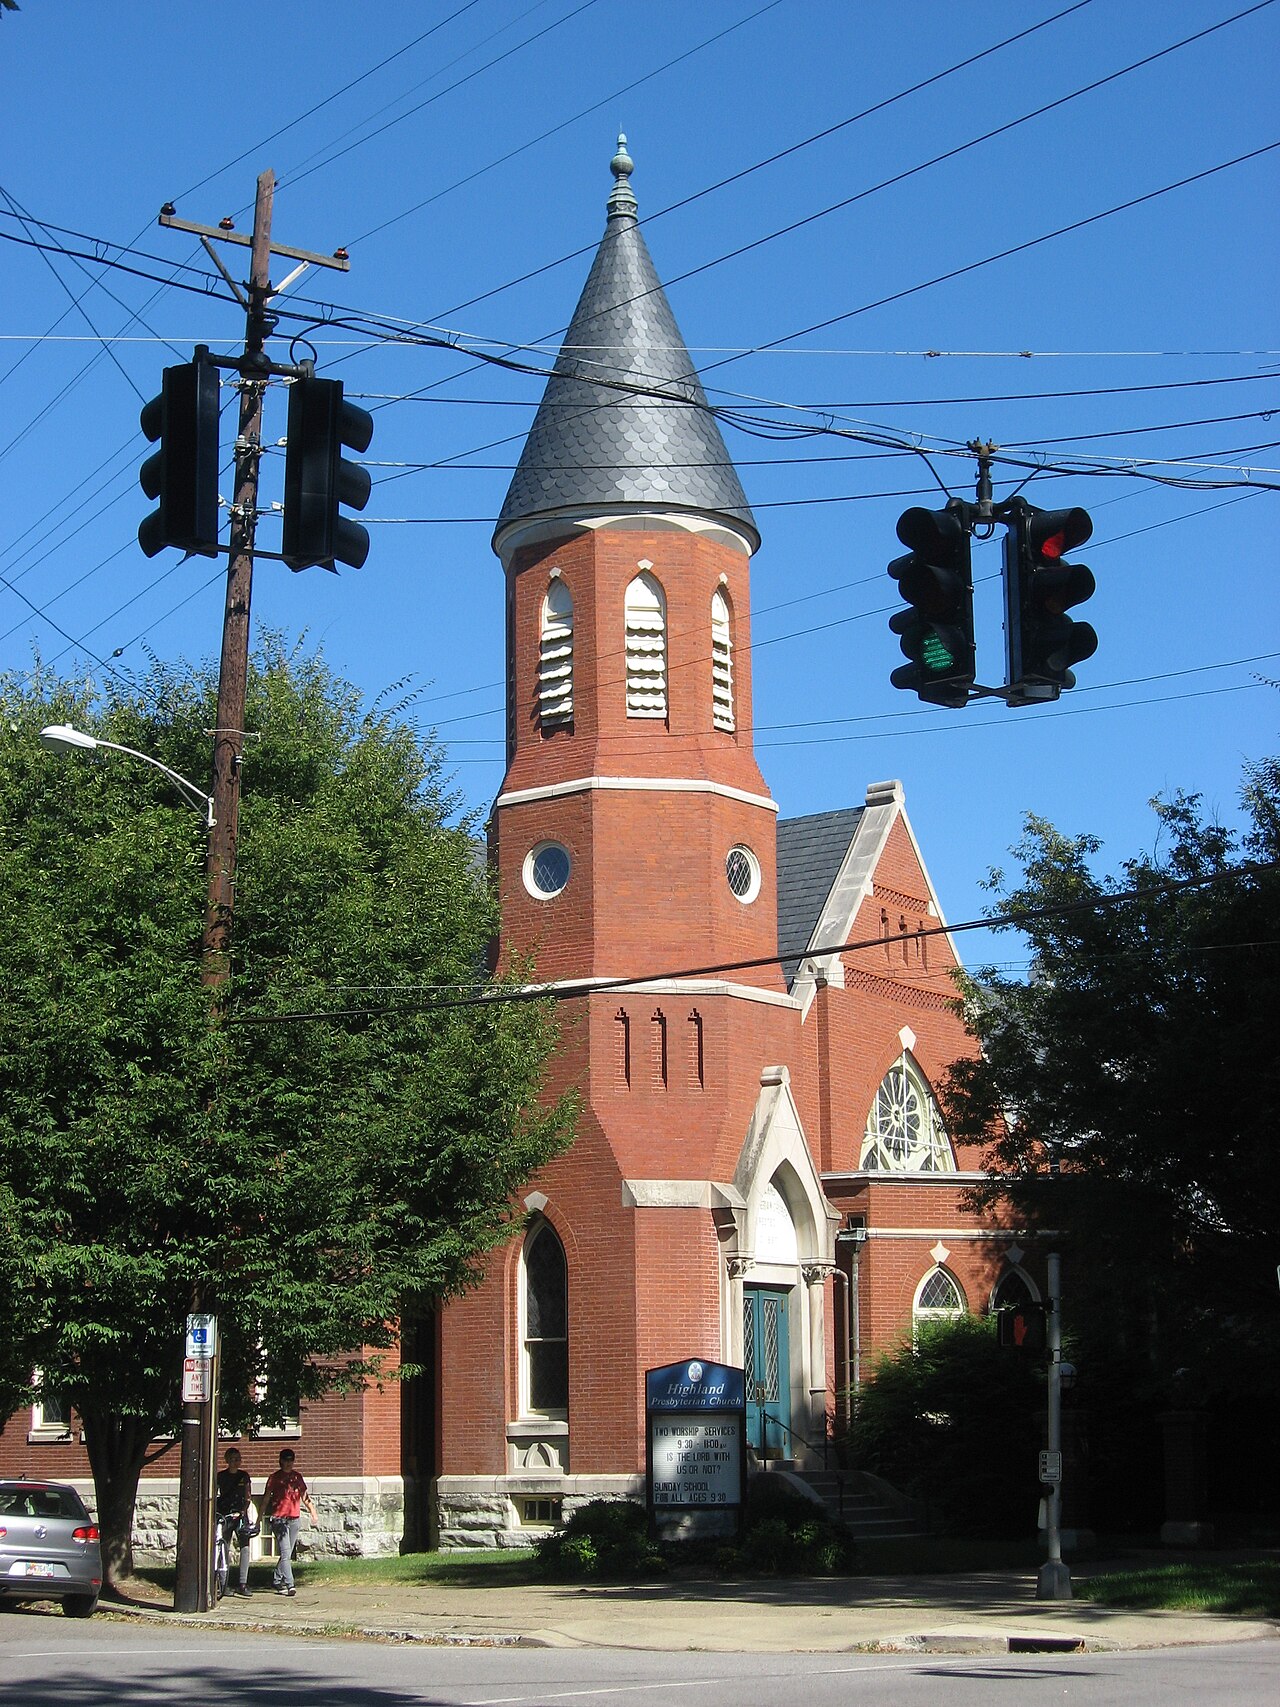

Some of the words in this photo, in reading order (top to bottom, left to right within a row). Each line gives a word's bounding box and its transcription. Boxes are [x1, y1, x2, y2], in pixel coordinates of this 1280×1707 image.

[186, 1361, 195, 1370] NO
[191, 1374, 202, 1382] ANY
[191, 1384, 203, 1392] TIME
[667, 1383, 725, 1397] Highland
[651, 1397, 706, 1408] Presbyterian
[709, 1396, 741, 1405] Church
[655, 1427, 669, 1436] TWO
[671, 1426, 699, 1436] WORSHIP
[704, 1426, 736, 1436] SERVICES
[666, 1452, 674, 1462] IS
[677, 1452, 690, 1462] THE
[693, 1452, 710, 1462] LORD
[714, 1452, 731, 1462] WITH
[676, 1465, 687, 1475] US
[688, 1465, 698, 1475] OR
[702, 1465, 721, 1475] NOT?
[654, 1482, 681, 1492] SUNDAY
[683, 1482, 710, 1492] SCHOOL
[655, 1493, 668, 1503] FOR
[671, 1493, 685, 1503] ALL
[689, 1493, 707, 1503] AGES
